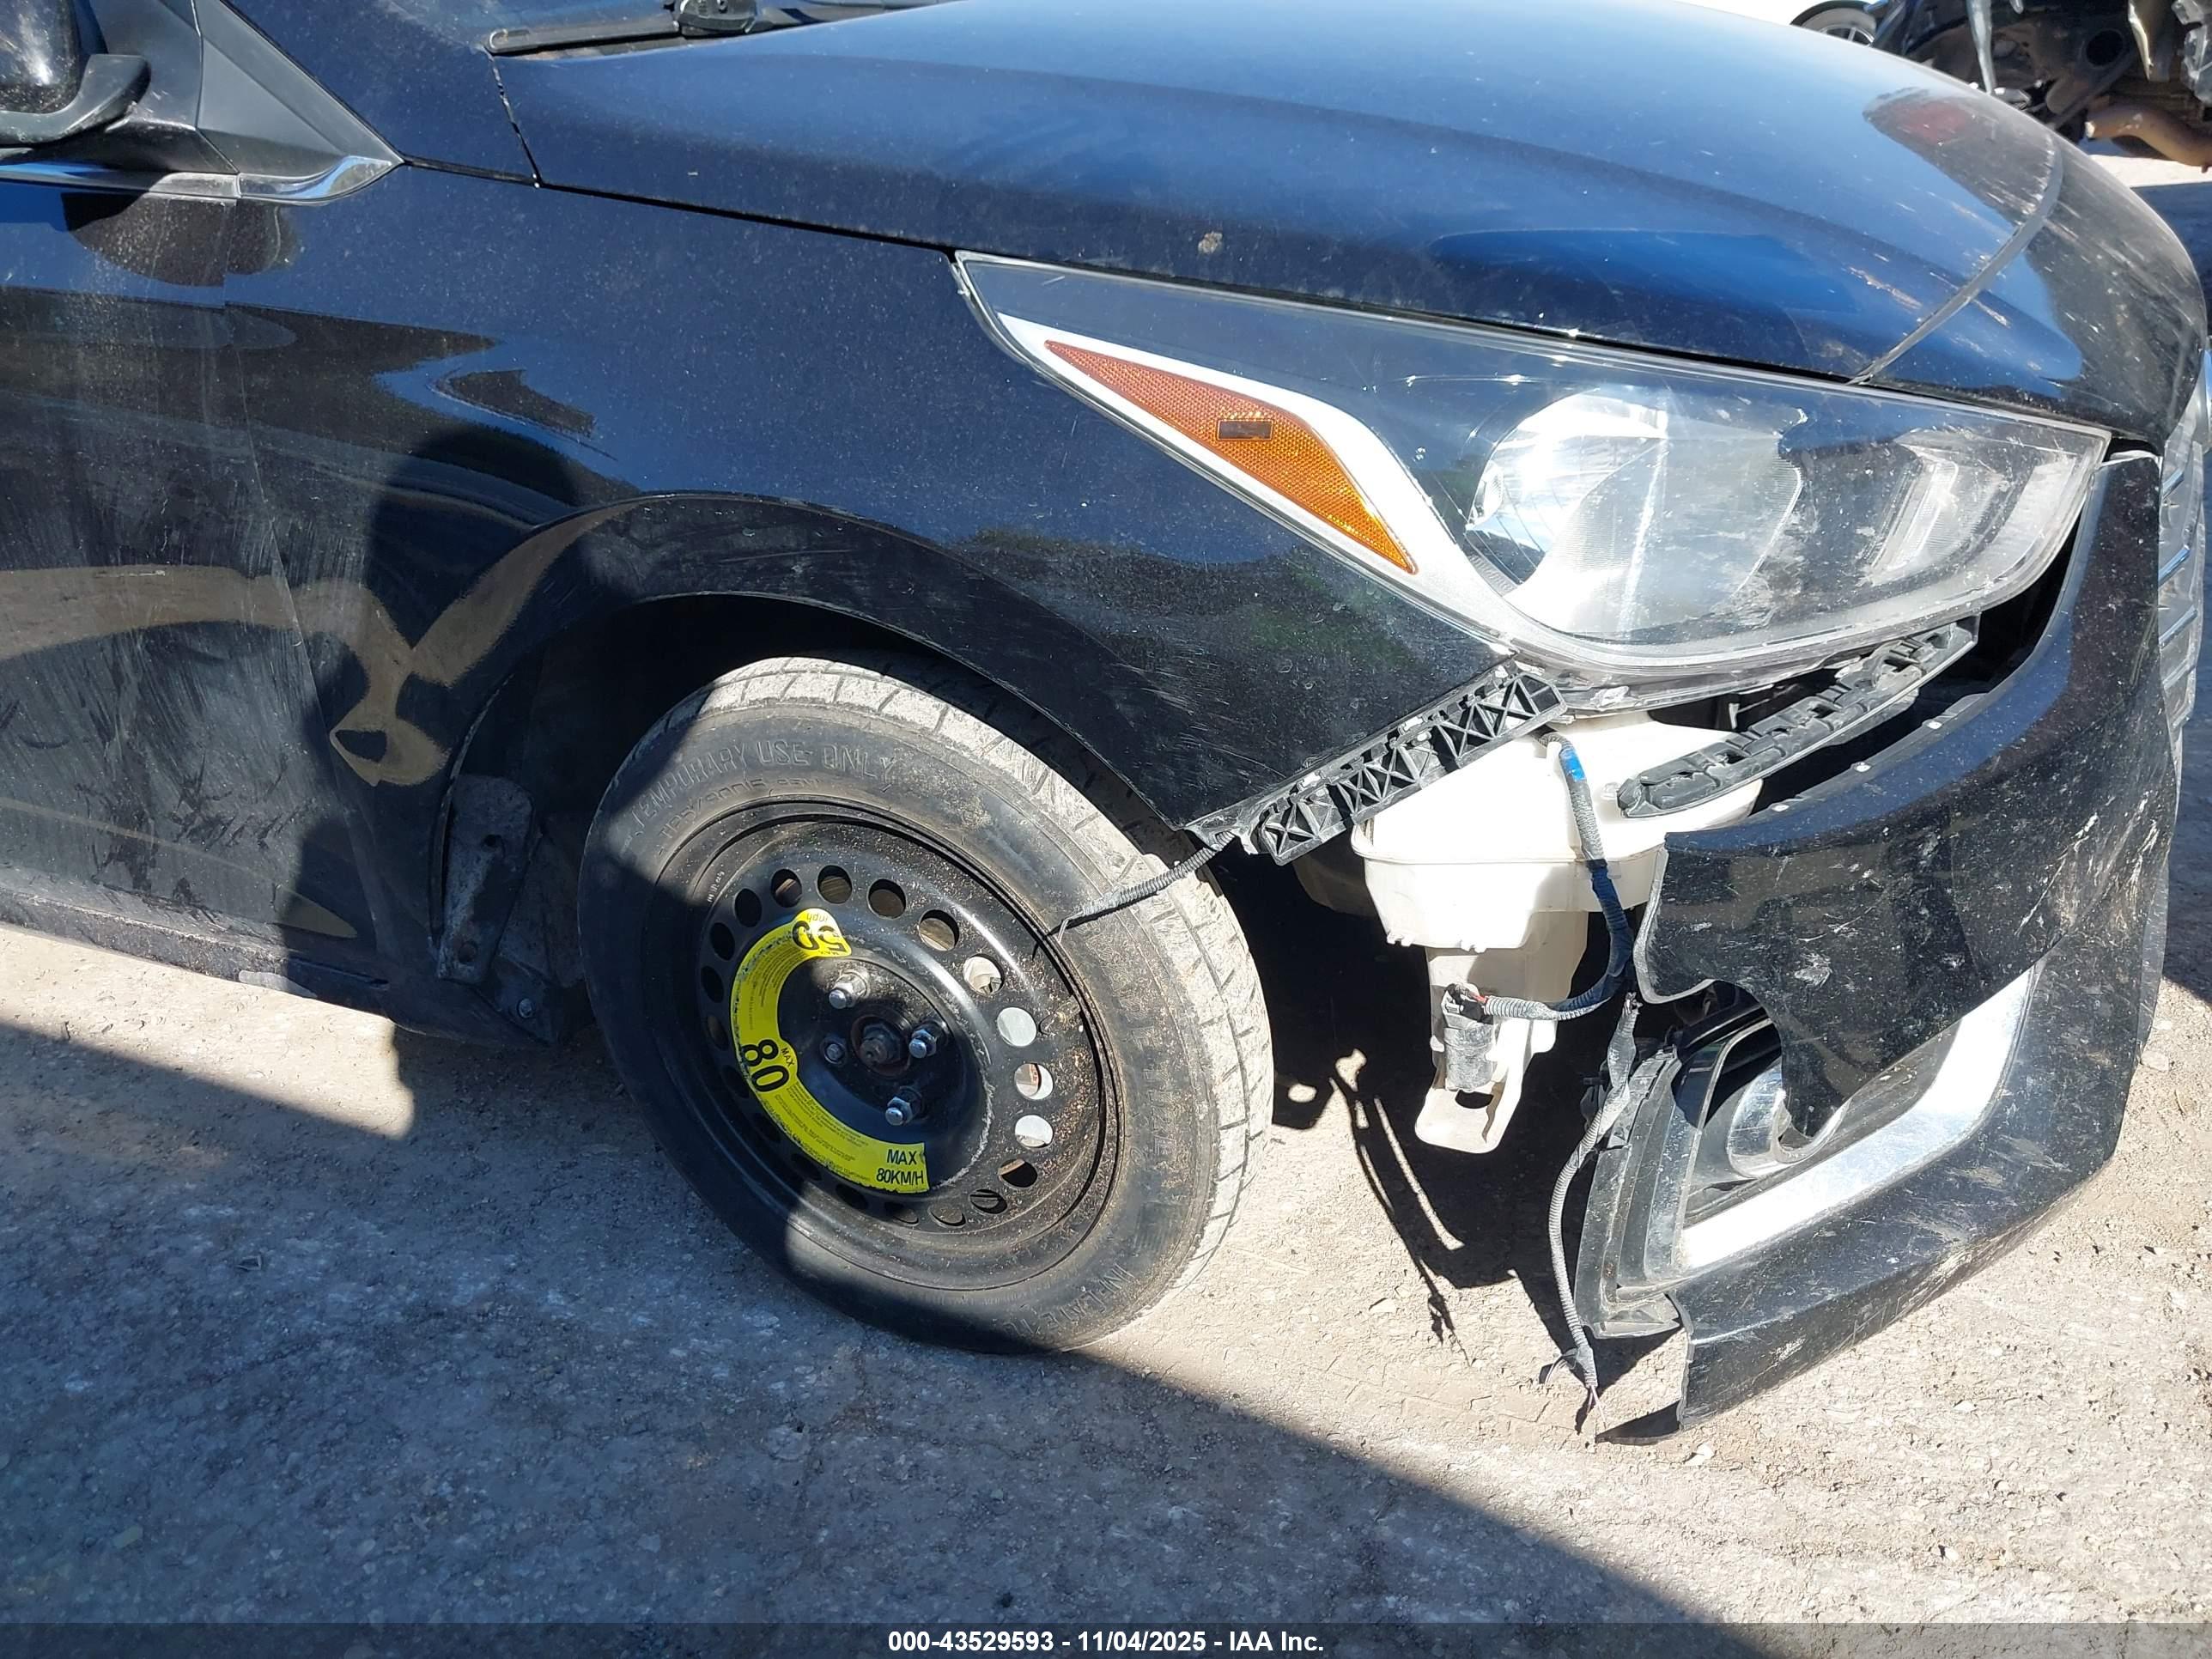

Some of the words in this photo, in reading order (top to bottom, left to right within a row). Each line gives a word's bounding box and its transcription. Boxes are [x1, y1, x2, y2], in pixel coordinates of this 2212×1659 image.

[757, 739, 811, 766] USE
[823, 744, 897, 785] ONLY
[792, 921, 848, 951] 50
[741, 1039, 790, 1092] 80
[780, 1047, 795, 1067] MAX
[887, 1149, 917, 1165] MAX
[876, 1168, 924, 1186] 80KM/H
